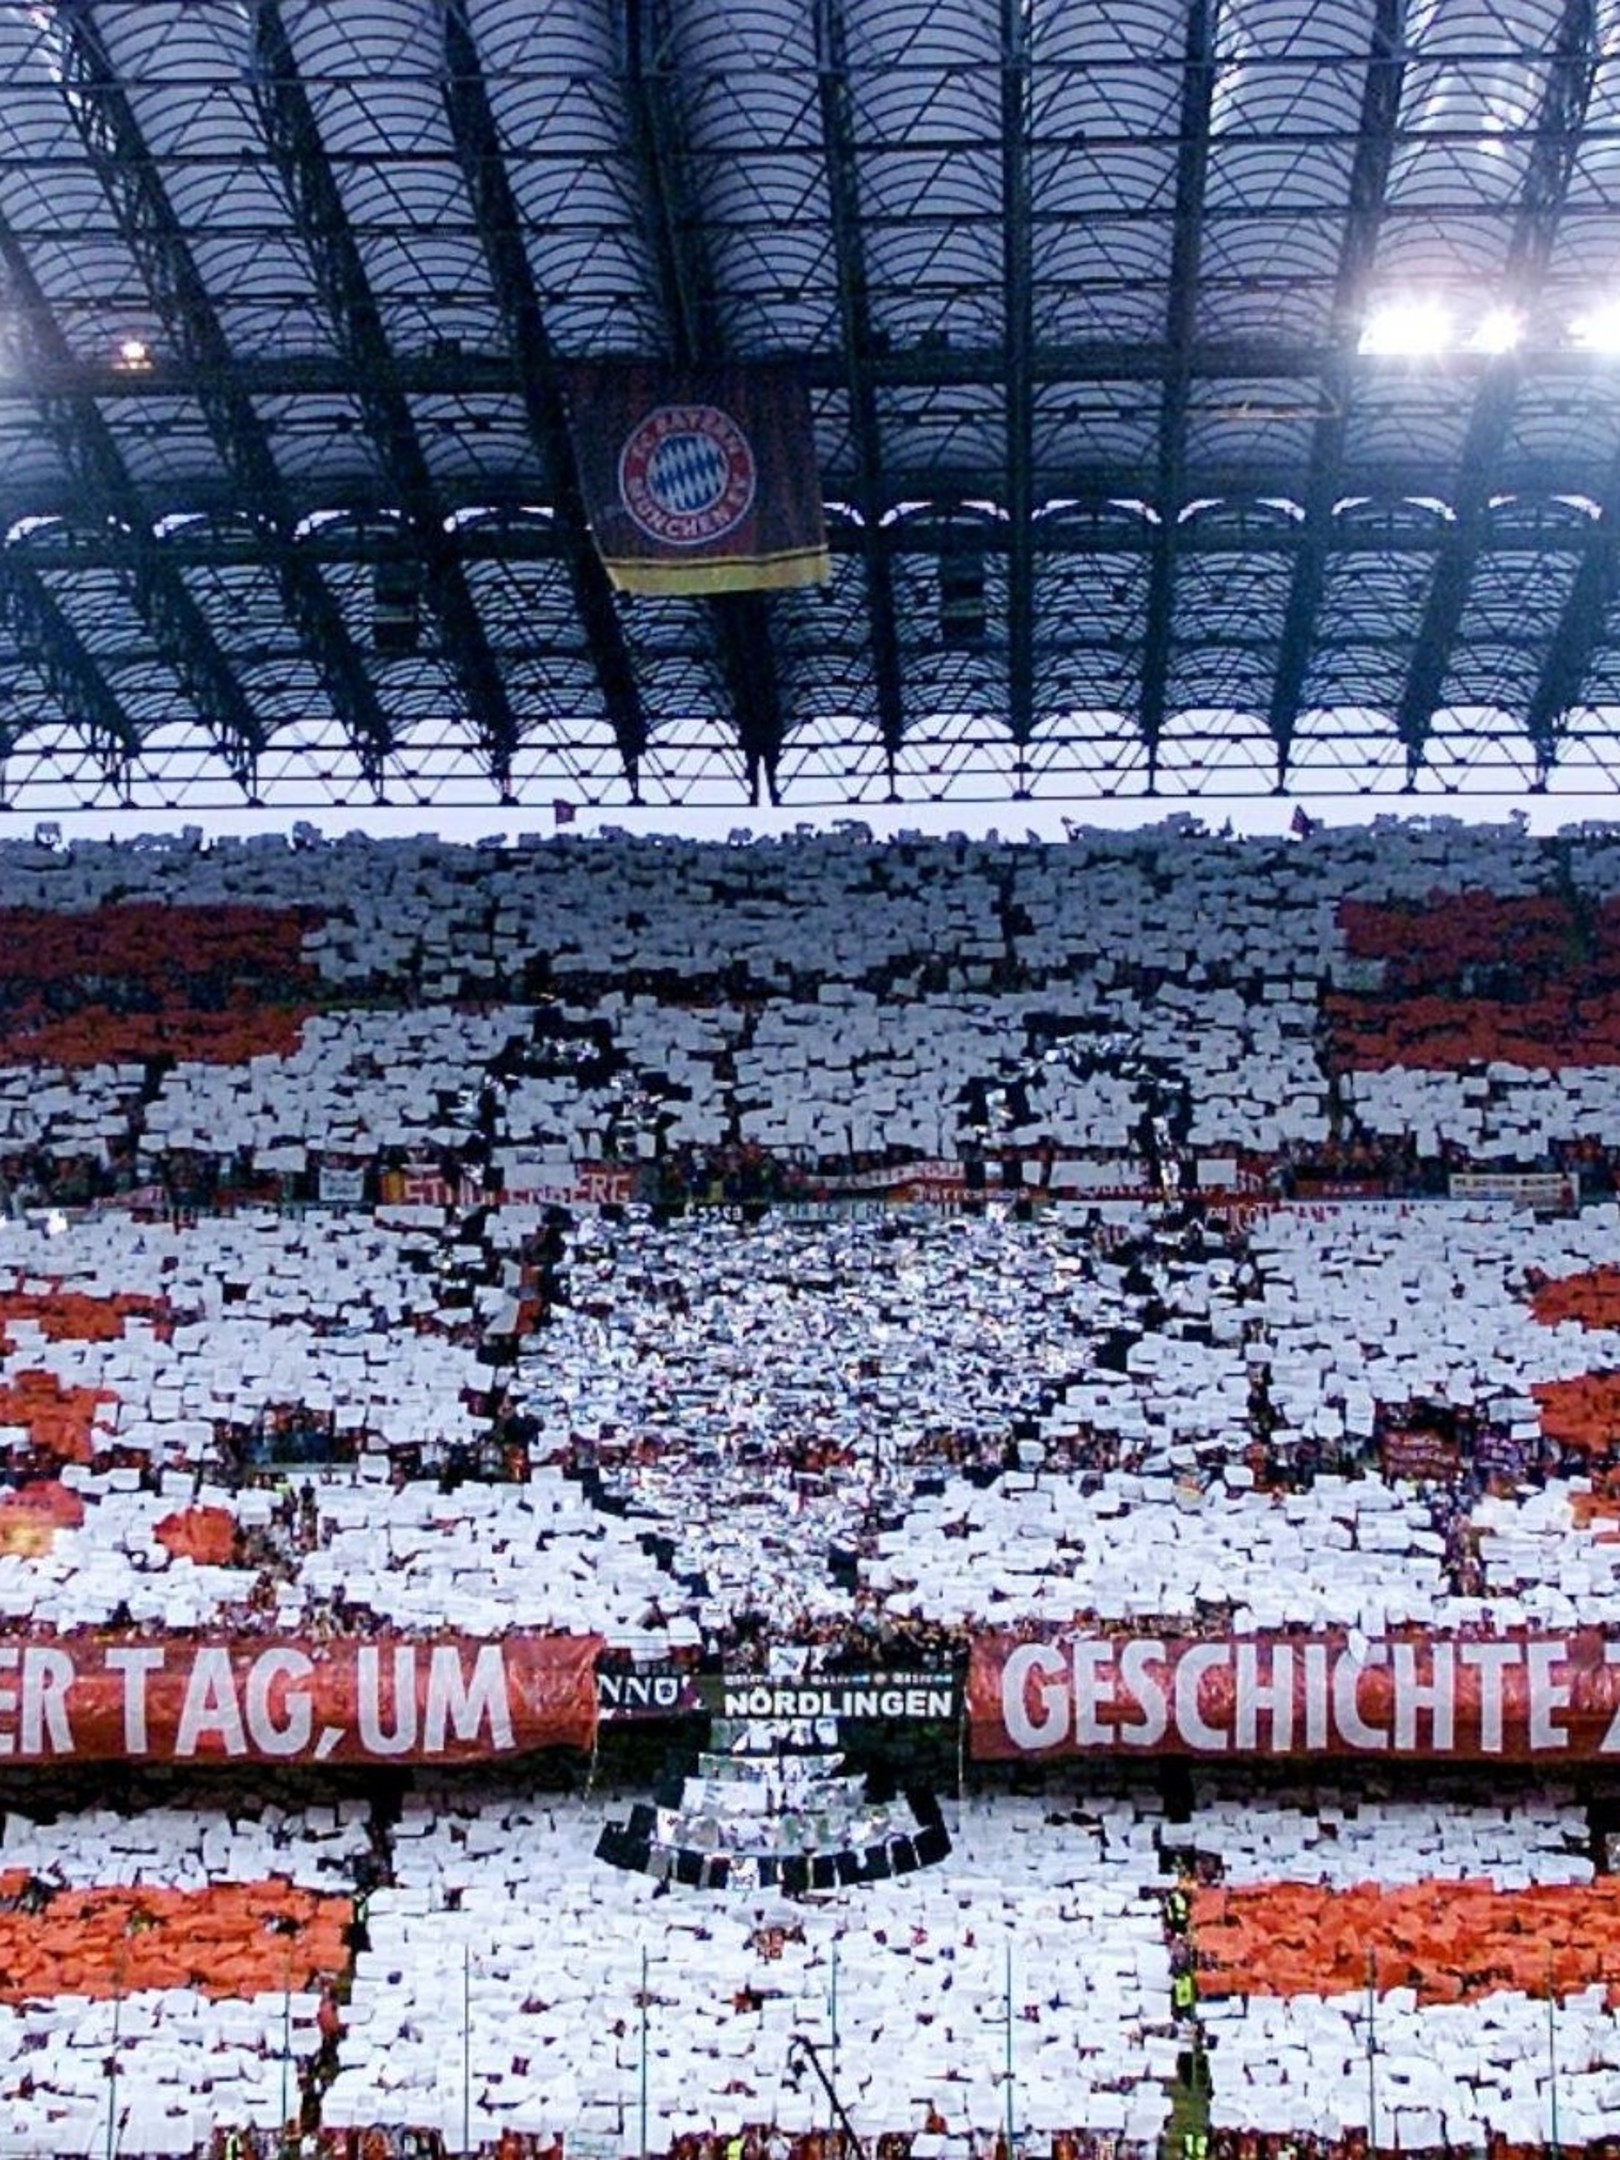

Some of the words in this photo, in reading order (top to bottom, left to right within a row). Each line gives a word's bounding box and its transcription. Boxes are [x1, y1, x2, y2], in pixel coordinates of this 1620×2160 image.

[104, 1646, 346, 1760] TAG,
[357, 1645, 517, 1755] UM
[1001, 1639, 1572, 1753] GESCHICHTE
